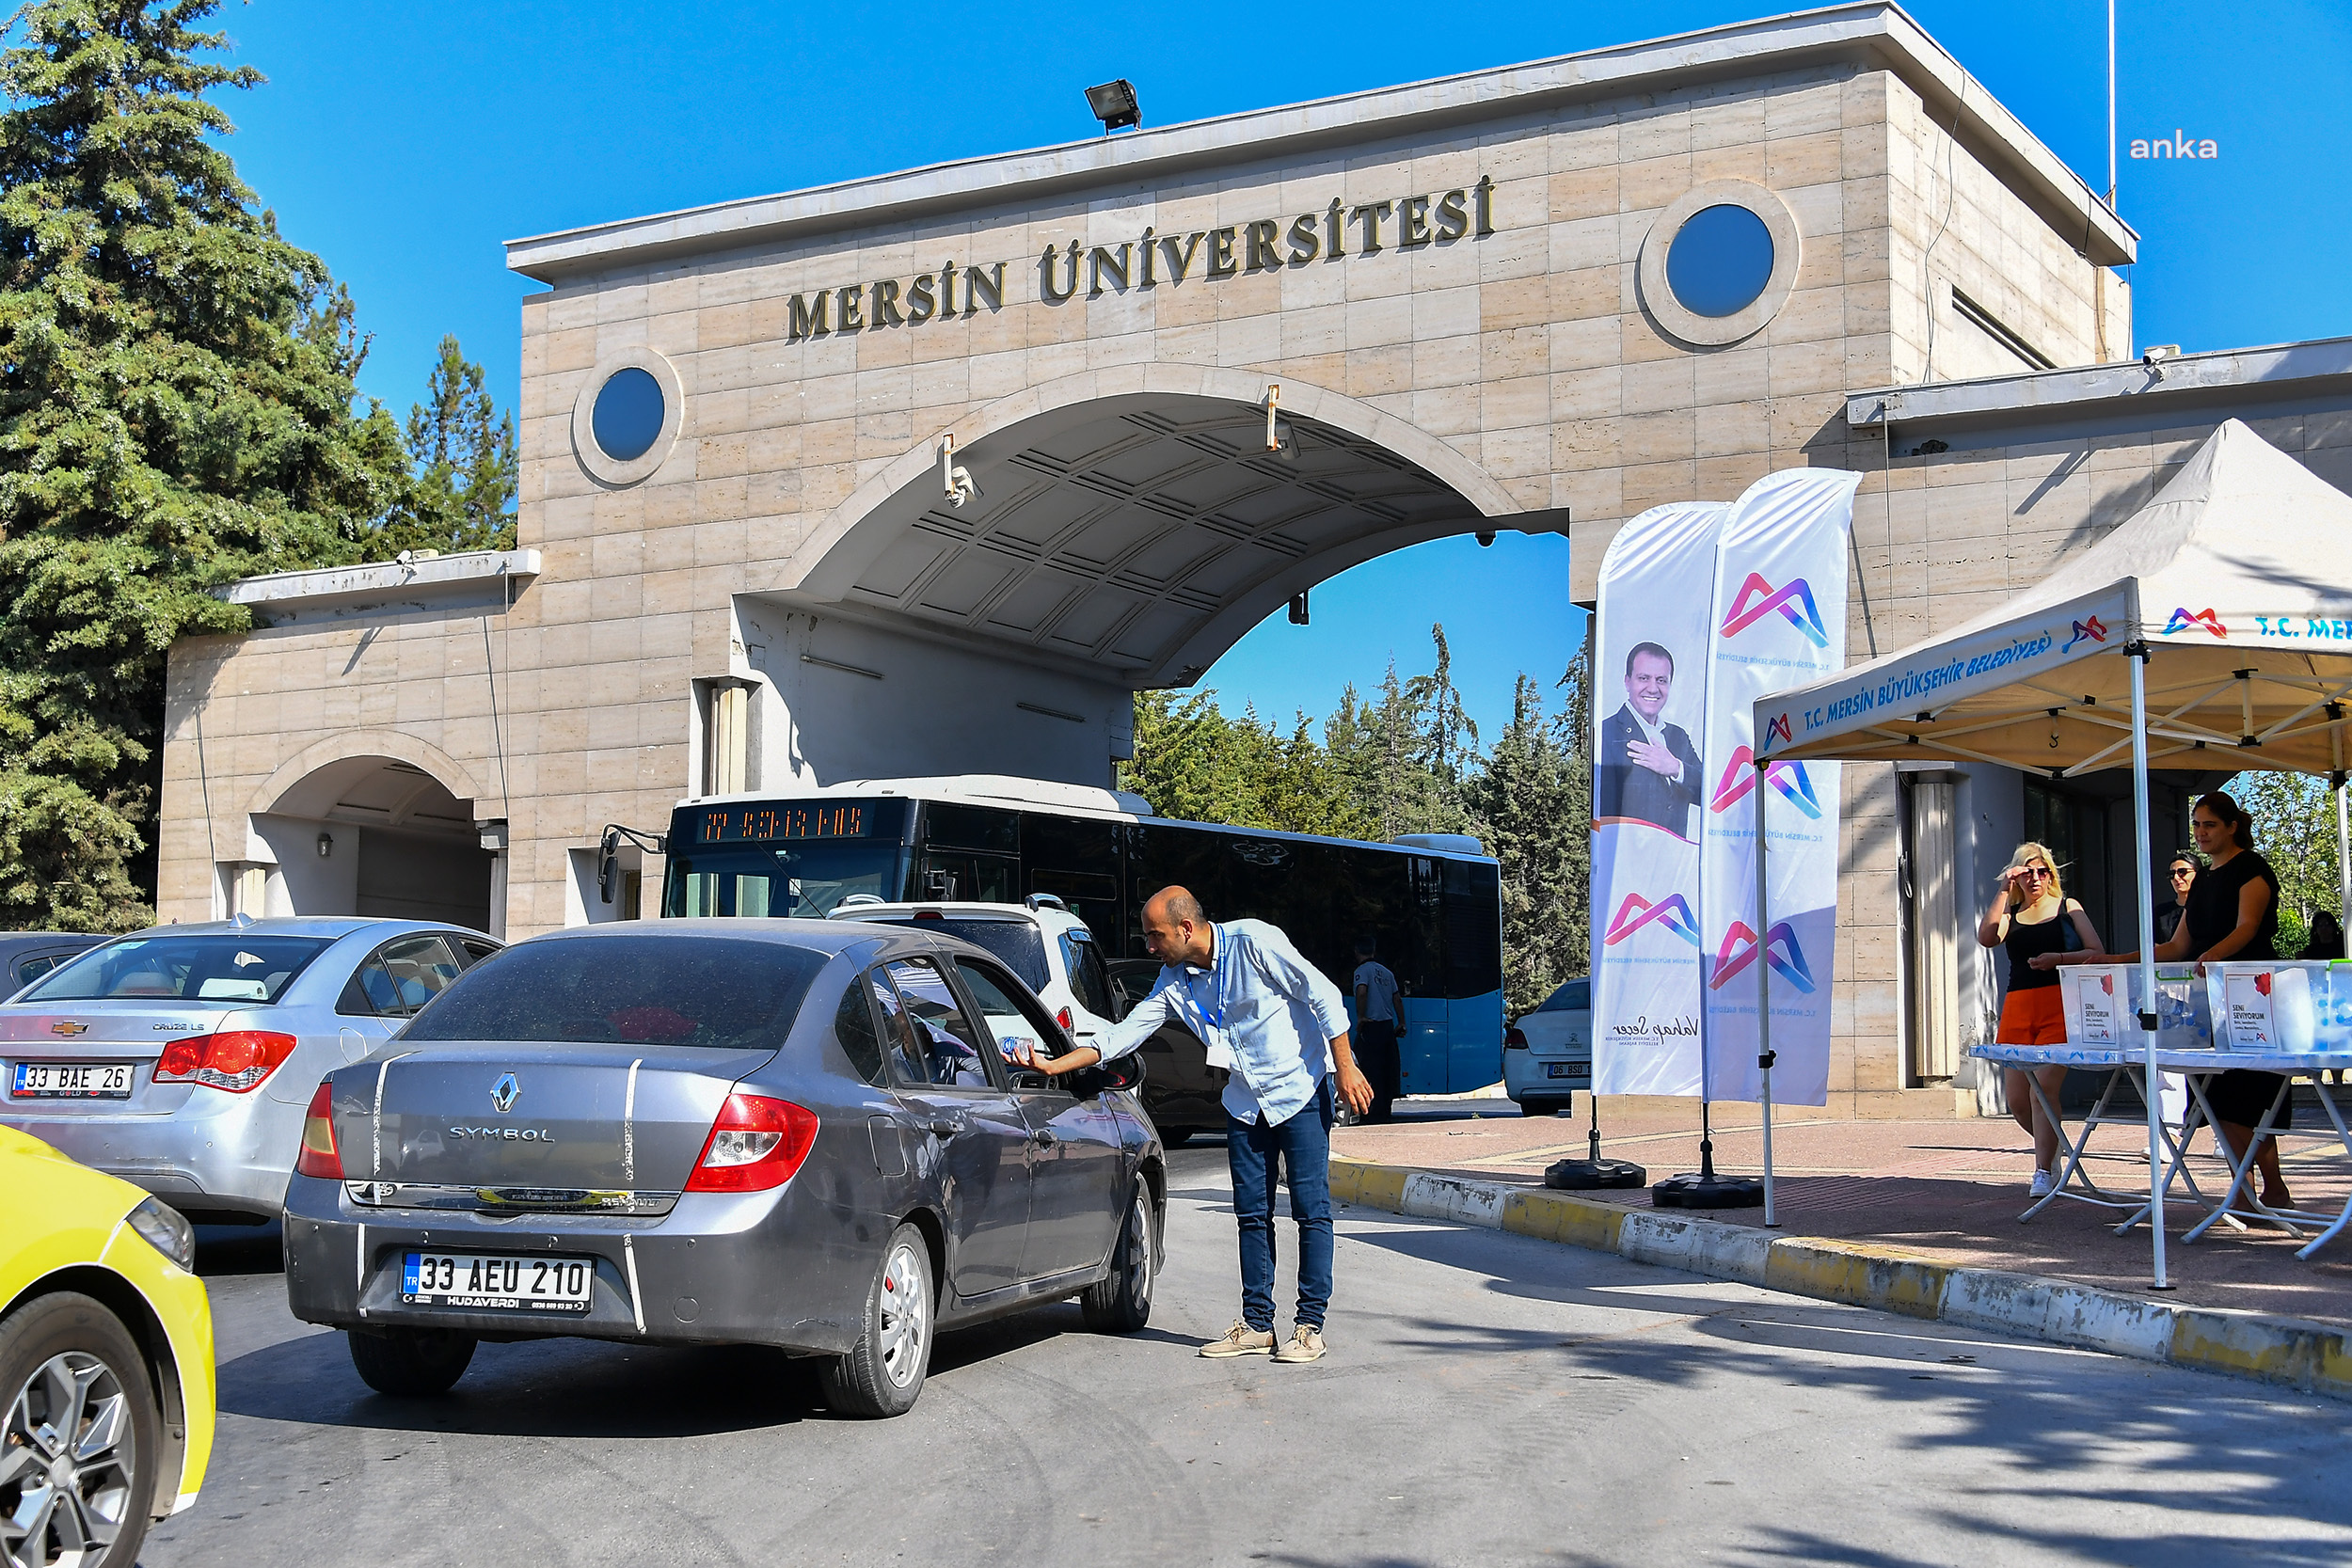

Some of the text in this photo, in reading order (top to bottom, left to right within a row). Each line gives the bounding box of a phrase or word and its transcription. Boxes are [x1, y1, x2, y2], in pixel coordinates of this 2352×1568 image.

[787, 175, 1496, 342] MERSİN ÜNİVERSİTESİ
[2255, 617, 2299, 638] T.C.
[1804, 630, 2052, 731] T.C. MERSİN BÜYÜKŞEHİR BELEDİYESİ
[26, 1068, 47, 1088] 33
[58, 1068, 92, 1088] BAE
[103, 1068, 124, 1088] 26
[1553, 1065, 1564, 1074] 06
[449, 1126, 556, 1143] SYMBOL
[406, 1257, 584, 1295] TR 33 AEU 210
